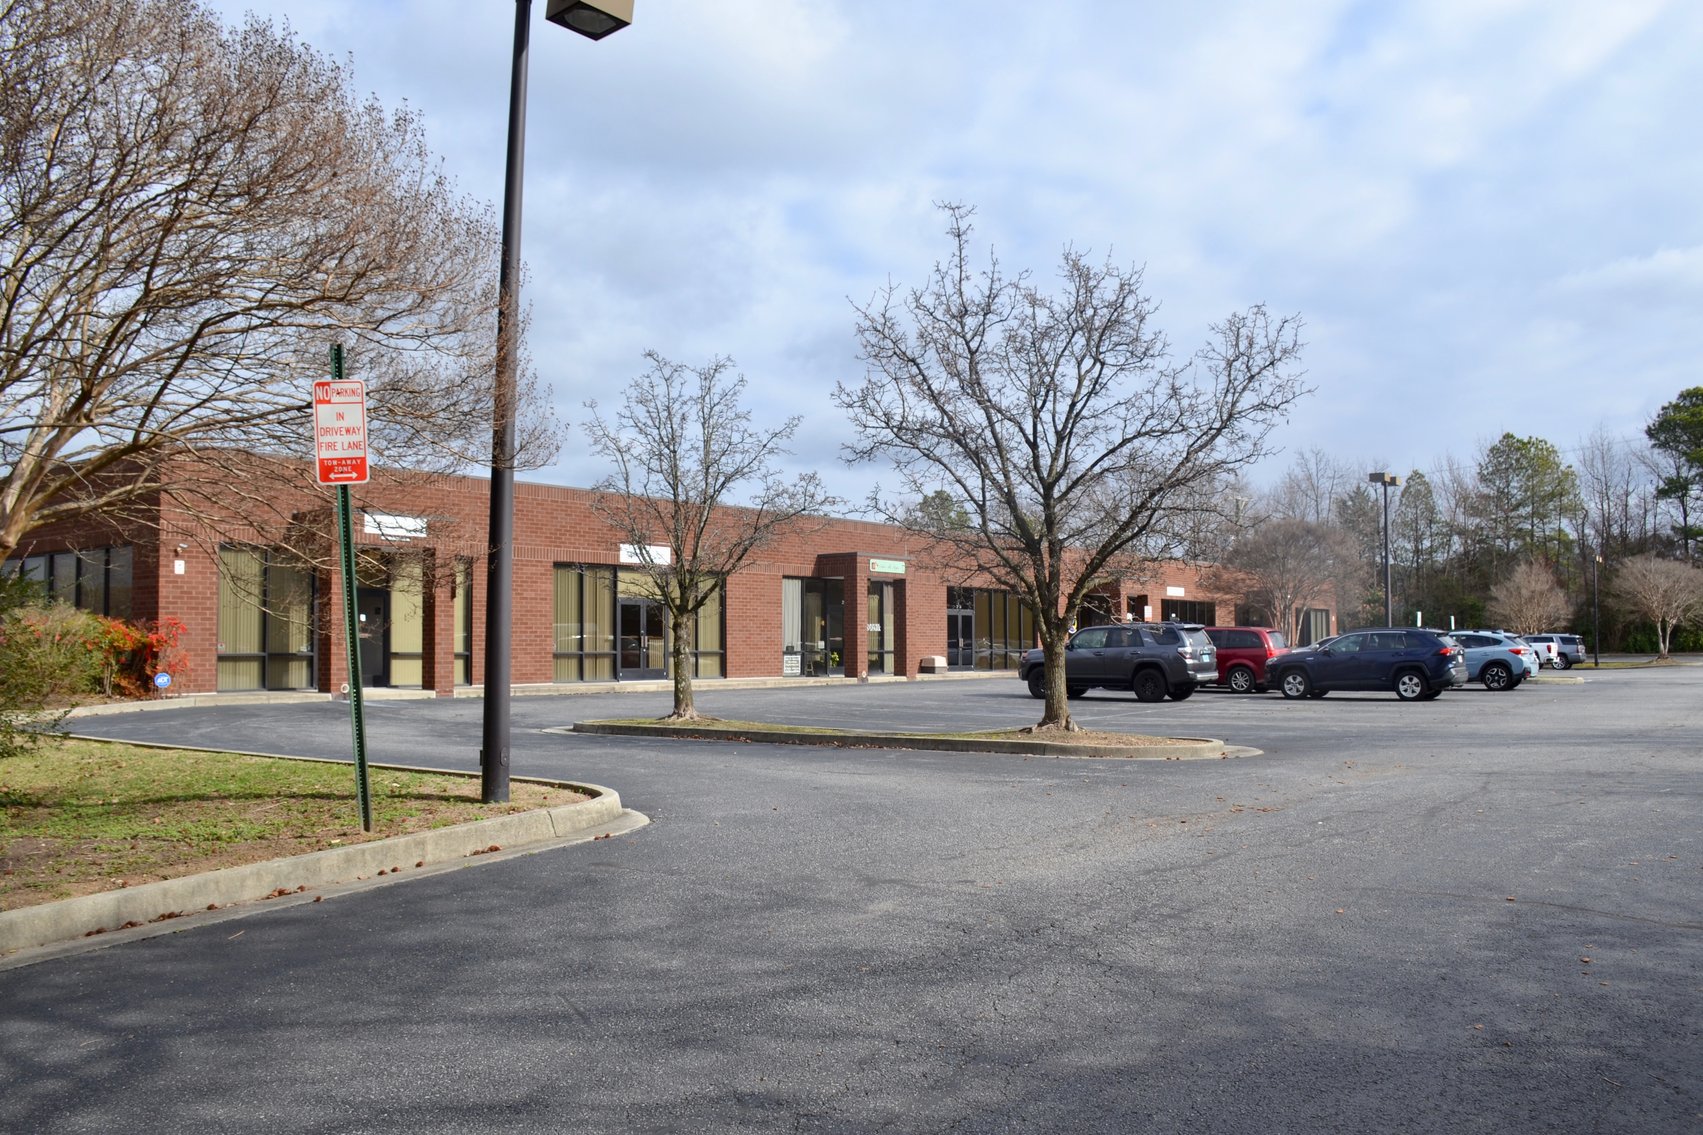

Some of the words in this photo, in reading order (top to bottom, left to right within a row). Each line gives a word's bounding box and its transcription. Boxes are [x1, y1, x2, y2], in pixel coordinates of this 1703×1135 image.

[315, 386, 330, 401] NO
[331, 388, 361, 398] PARKING
[335, 411, 345, 421] IN
[319, 426, 361, 437] DRIVEWAY
[320, 441, 339, 451] FIRE
[341, 440, 364, 451] LANE
[334, 465, 352, 473] ZONE
